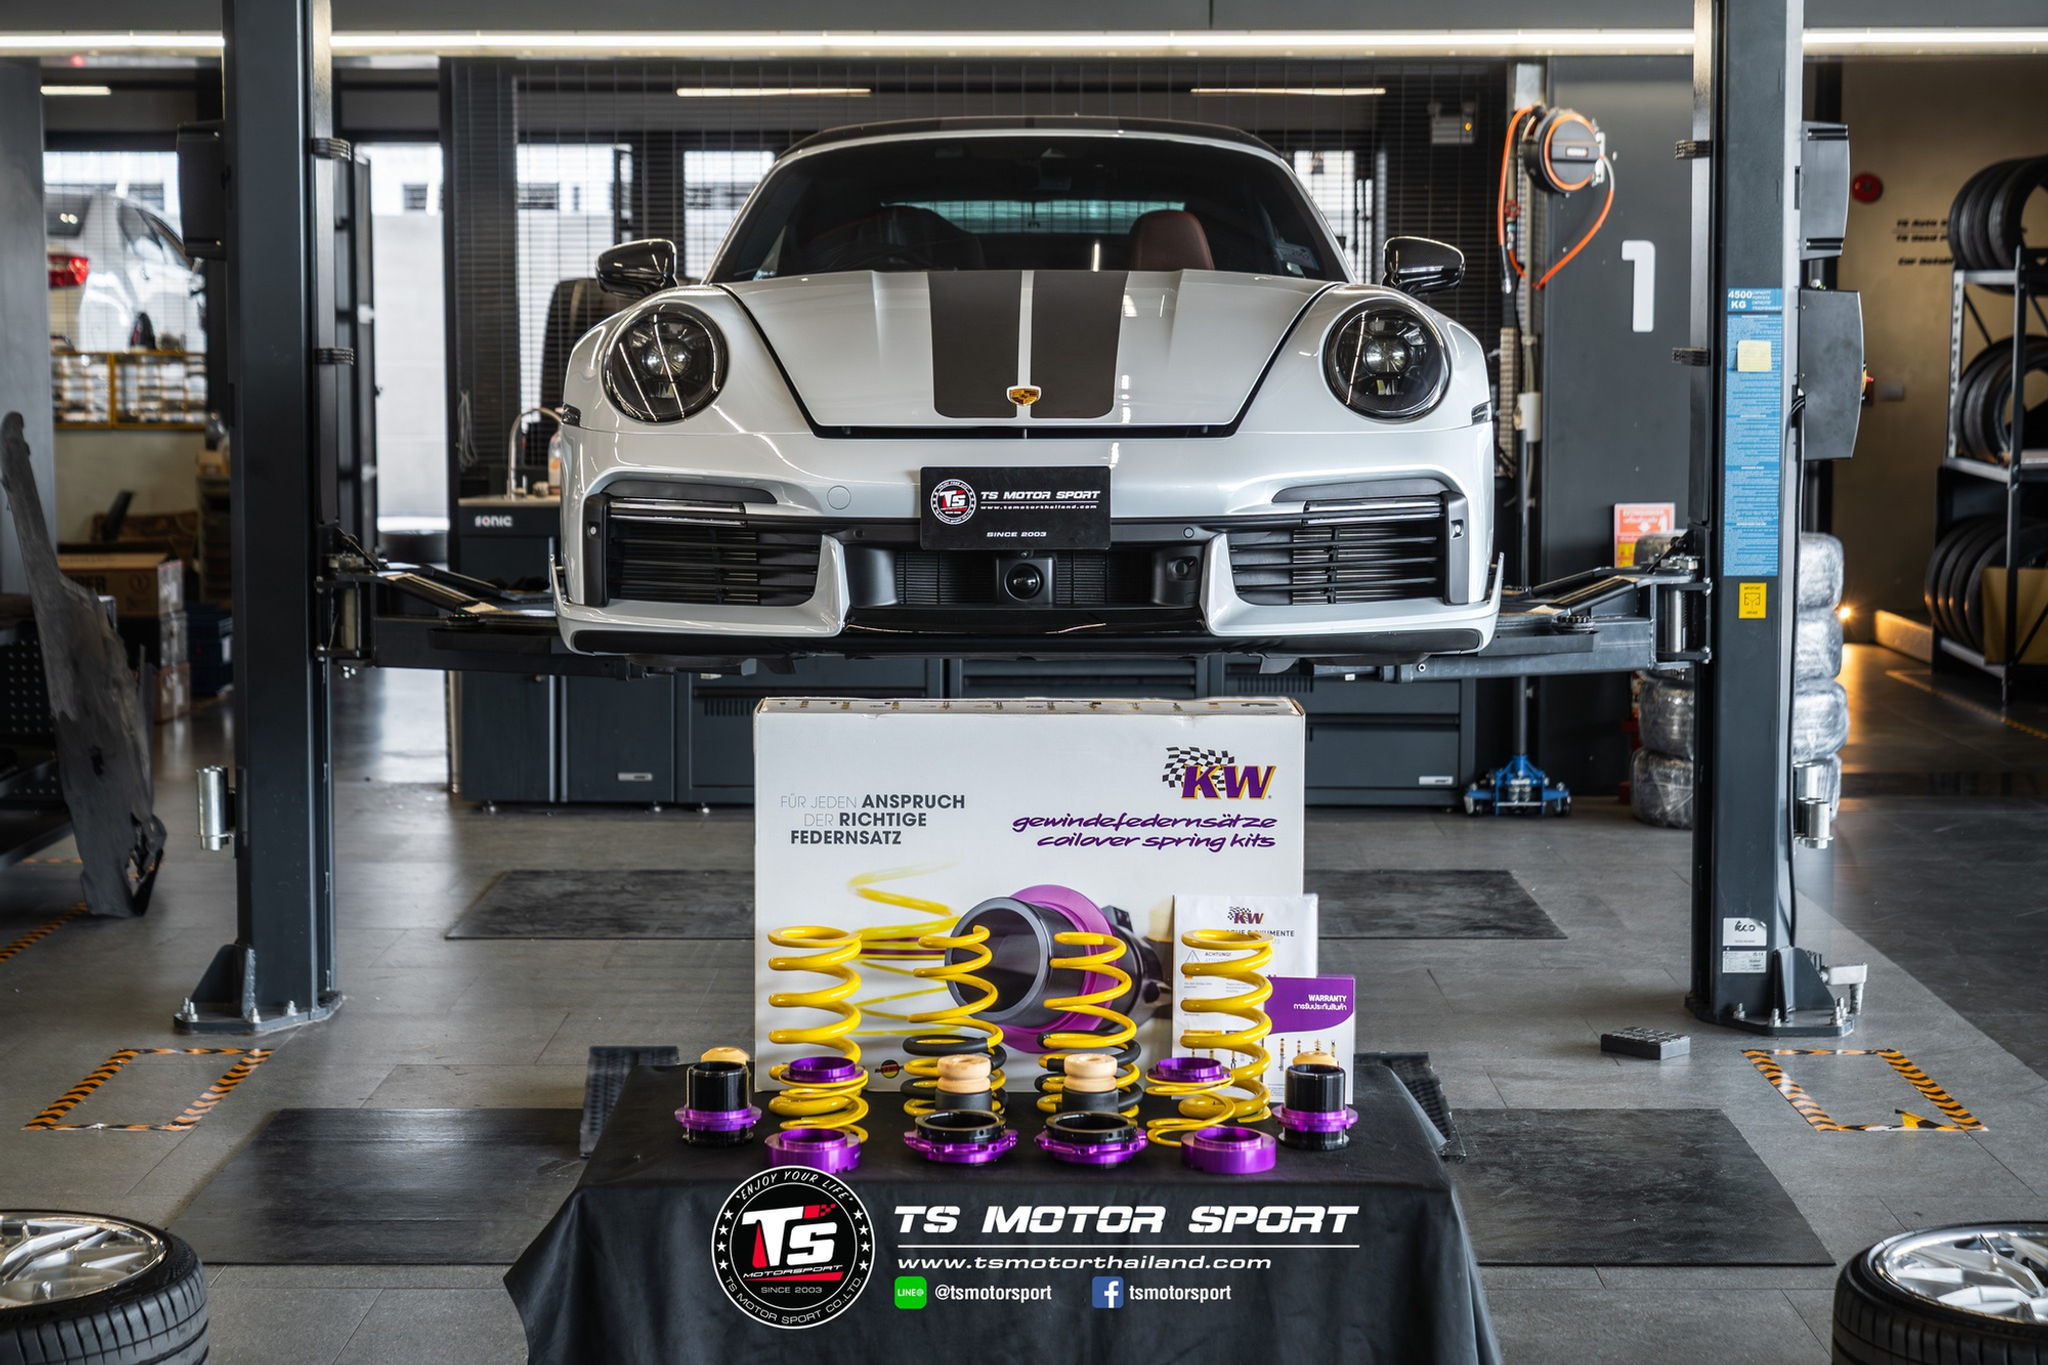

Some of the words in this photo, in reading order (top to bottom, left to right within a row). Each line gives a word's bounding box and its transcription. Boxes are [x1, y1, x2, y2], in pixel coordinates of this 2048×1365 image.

[1622, 240, 1656, 332] 1
[1728, 290, 1753, 299] 4500
[1731, 300, 1746, 309] KG
[980, 491, 998, 499] TS
[1003, 491, 1050, 499] MOTOR
[1056, 491, 1100, 499] SPORT
[1181, 764, 1277, 800] KW
[780, 793, 807, 808] FÜR
[811, 795, 857, 809] JEDEN
[862, 794, 965, 809] ANSPRUCH
[804, 813, 834, 827] DER
[839, 812, 927, 827] RICHTIGE
[1012, 812, 1277, 832] gewindefedernsätze
[791, 830, 902, 844] FEDERNSATZ
[1037, 832, 1141, 847] coilover
[1142, 833, 1227, 853] spring
[1230, 833, 1276, 848] kits
[1233, 911, 1264, 924] KW
[1308, 994, 1347, 1002] WARRANTY
